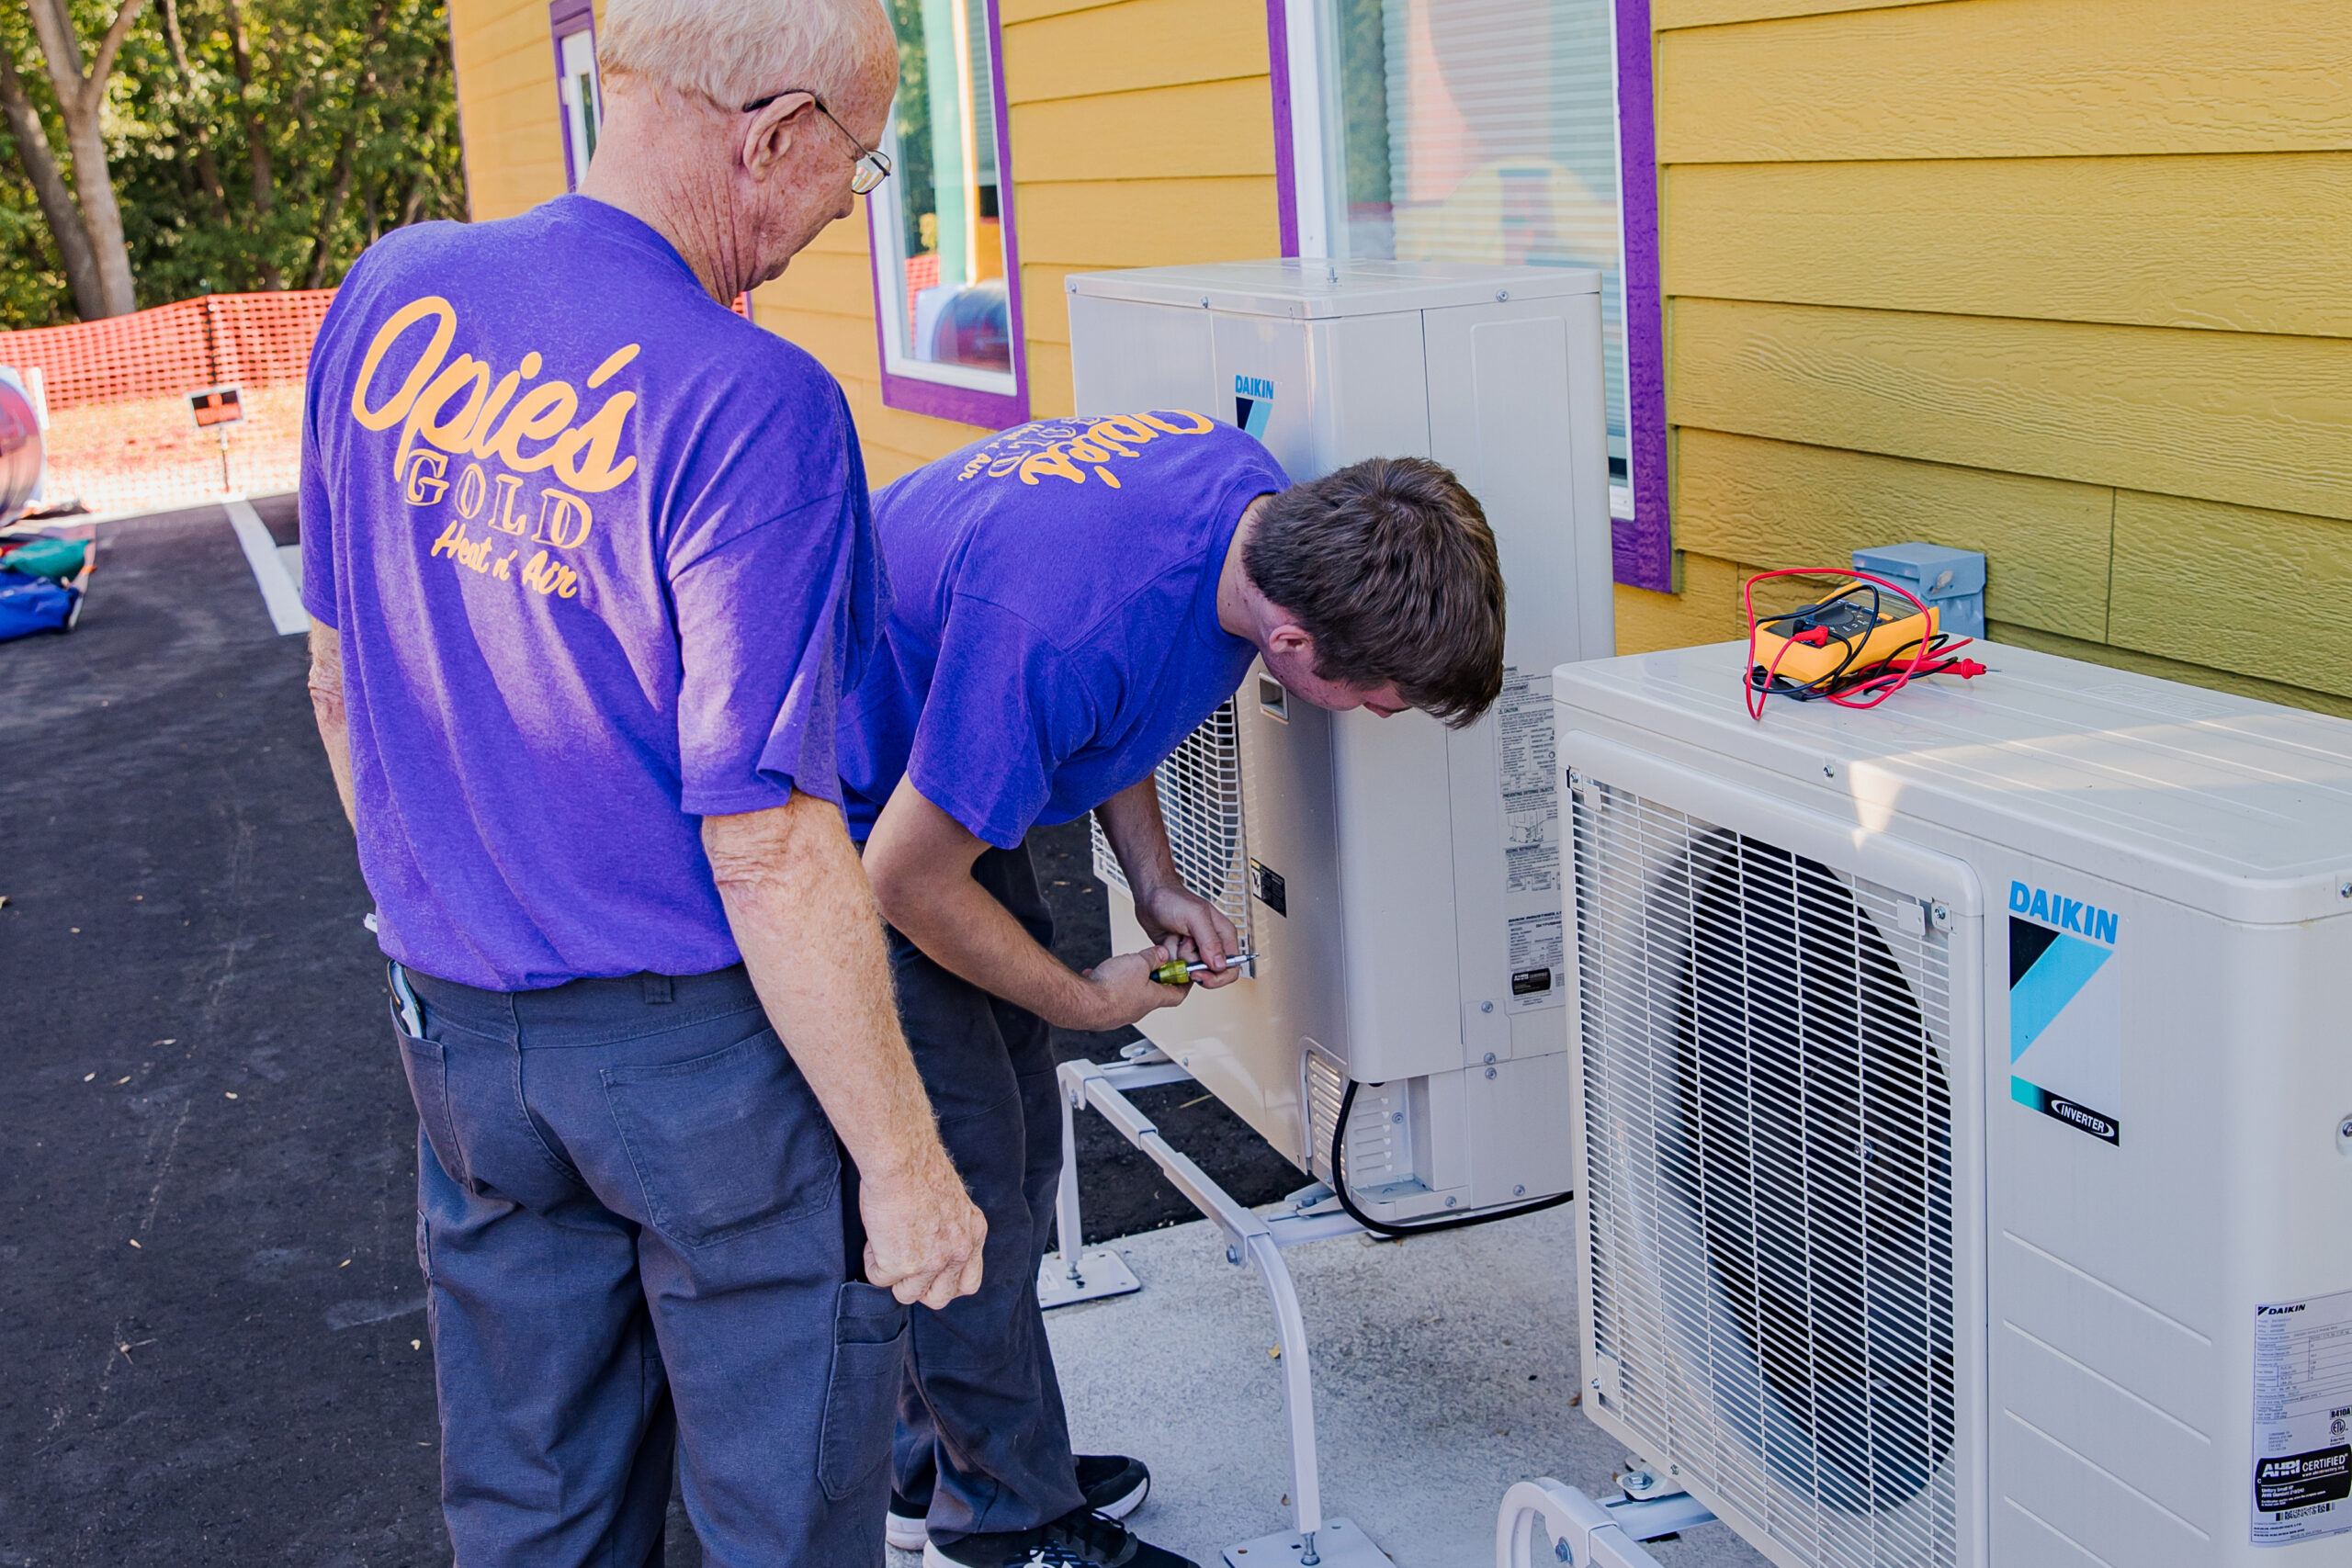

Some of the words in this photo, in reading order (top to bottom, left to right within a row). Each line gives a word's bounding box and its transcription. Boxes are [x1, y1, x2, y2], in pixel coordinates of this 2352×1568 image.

[351, 296, 640, 492] Opie's
[1235, 375, 1274, 400] DAIKIN
[404, 448, 593, 549] GOLD
[430, 520, 492, 574] Heat
[522, 549, 577, 598] Air
[2009, 880, 2119, 944] DAIKIN
[2061, 1104, 2105, 1134] INVERTER
[2268, 1303, 2306, 1315] DAIKIN
[2331, 1407, 2351, 1418] R410A
[2261, 1459, 2301, 1478] AHRI
[2301, 1455, 2346, 1472] CERTIFIED
